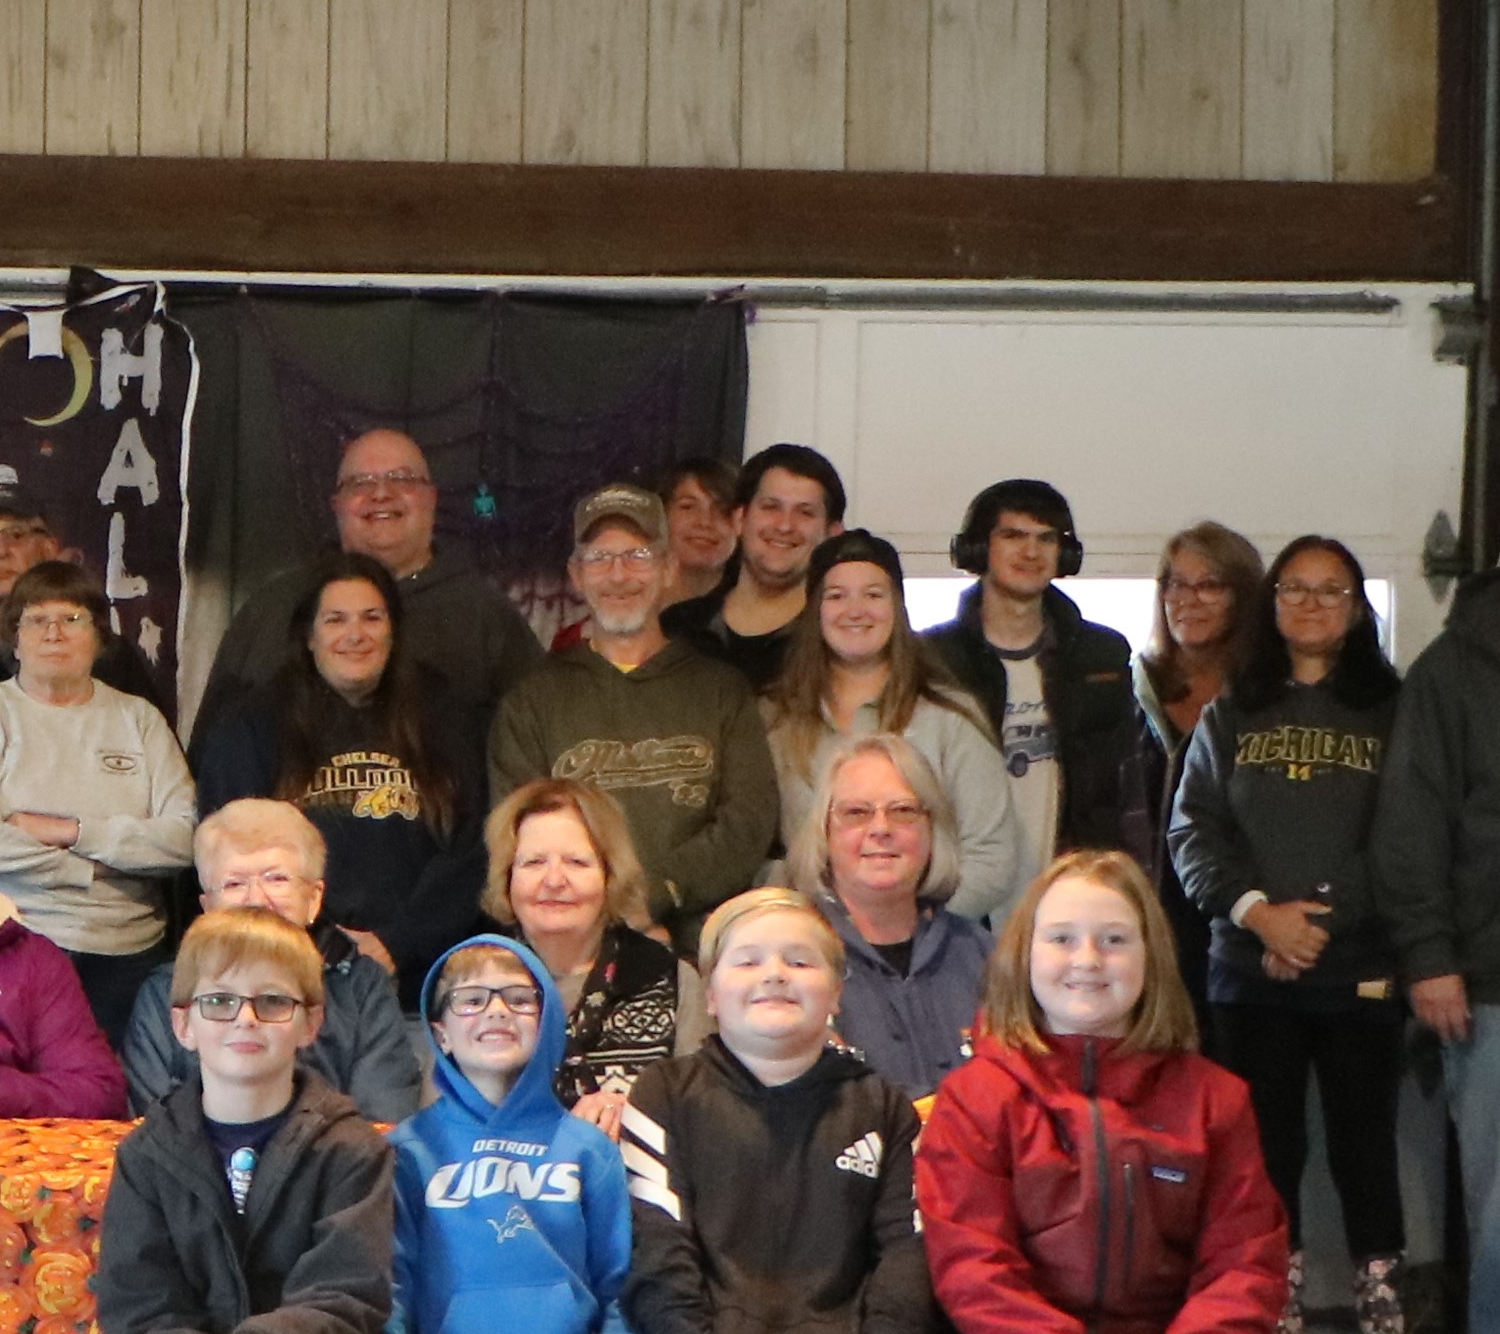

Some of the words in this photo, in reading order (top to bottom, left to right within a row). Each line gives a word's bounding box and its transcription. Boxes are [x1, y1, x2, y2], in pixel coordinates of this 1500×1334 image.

[331, 751, 400, 767] CHELSEA
[1234, 725, 1382, 774] MICHIGAN
[472, 1139, 549, 1157] DETROIT
[425, 1156, 582, 1209] LIONS
